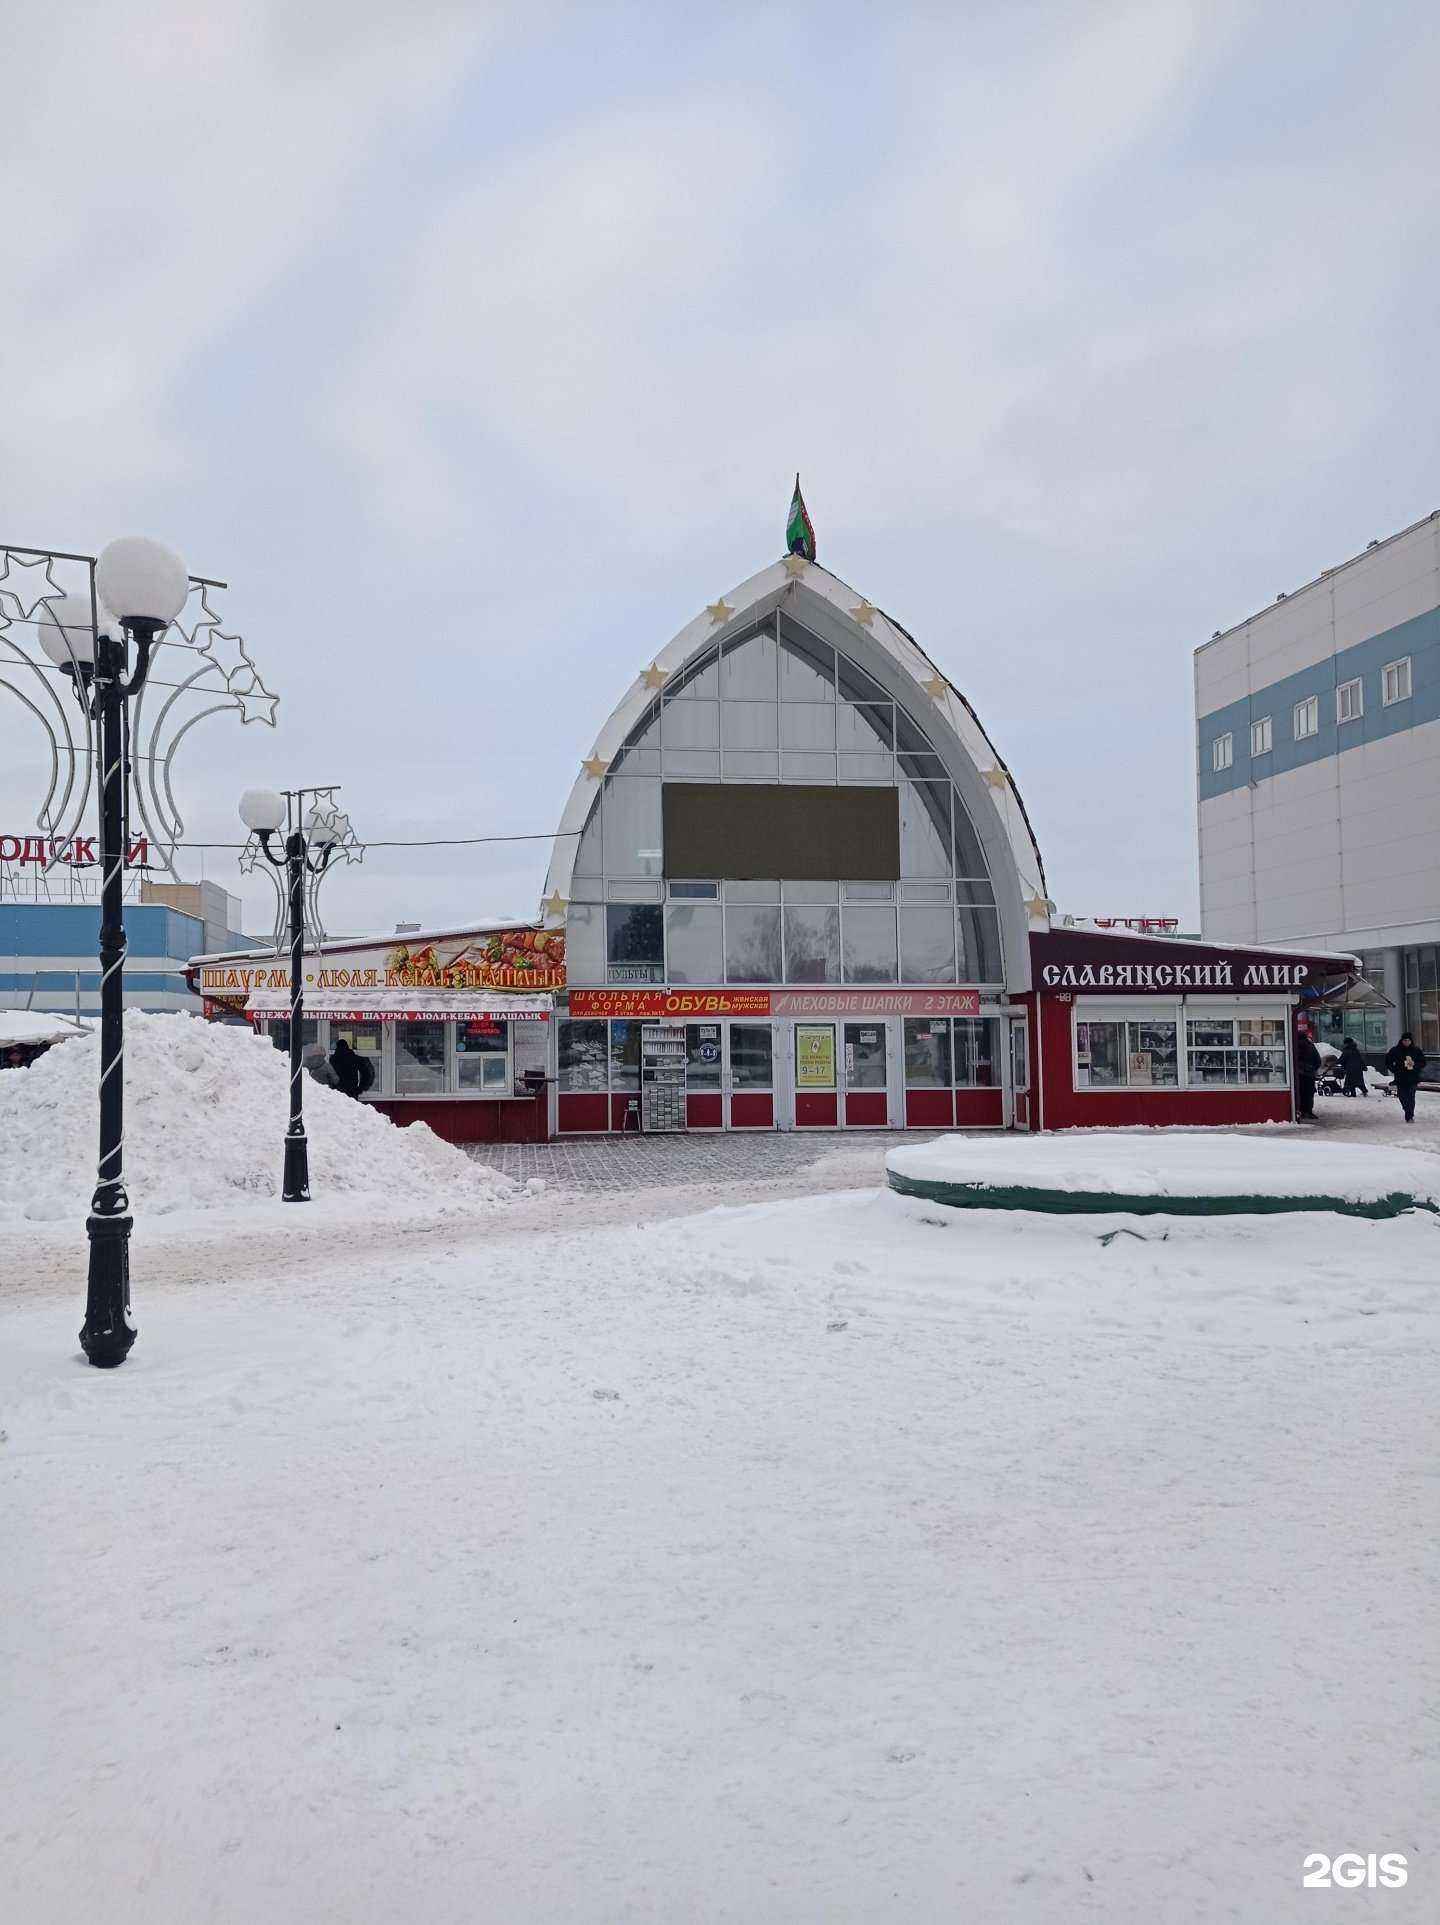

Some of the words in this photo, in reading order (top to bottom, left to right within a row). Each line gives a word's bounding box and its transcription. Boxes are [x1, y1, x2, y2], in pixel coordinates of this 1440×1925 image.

[0, 832, 147, 867] ОДСКЙ
[202, 969, 294, 993] ШАУРМ
[1042, 960, 1233, 987] СЛАВЯНСКИЙ
[1243, 964, 1309, 986] МИР
[574, 991, 662, 1001] ШКОЛЬНАЯ
[666, 996, 732, 1011] ОБУВЬ
[790, 996, 857, 1010] МЕХОВЫЕ
[861, 996, 912, 1010] ШАПКИ
[924, 996, 934, 1010] 2
[938, 995, 974, 1009] ЭТАЖ
[591, 1001, 646, 1010] ФОРМА
[253, 1011, 293, 1019] СВЕЖА
[303, 1011, 356, 1020] ВЫПЕЧКА
[362, 1011, 409, 1020] ШАУРМА
[415, 1011, 484, 1020] ЛЮЛЯ-КЕБАБ
[489, 1011, 542, 1020] ШАШЛЫК
